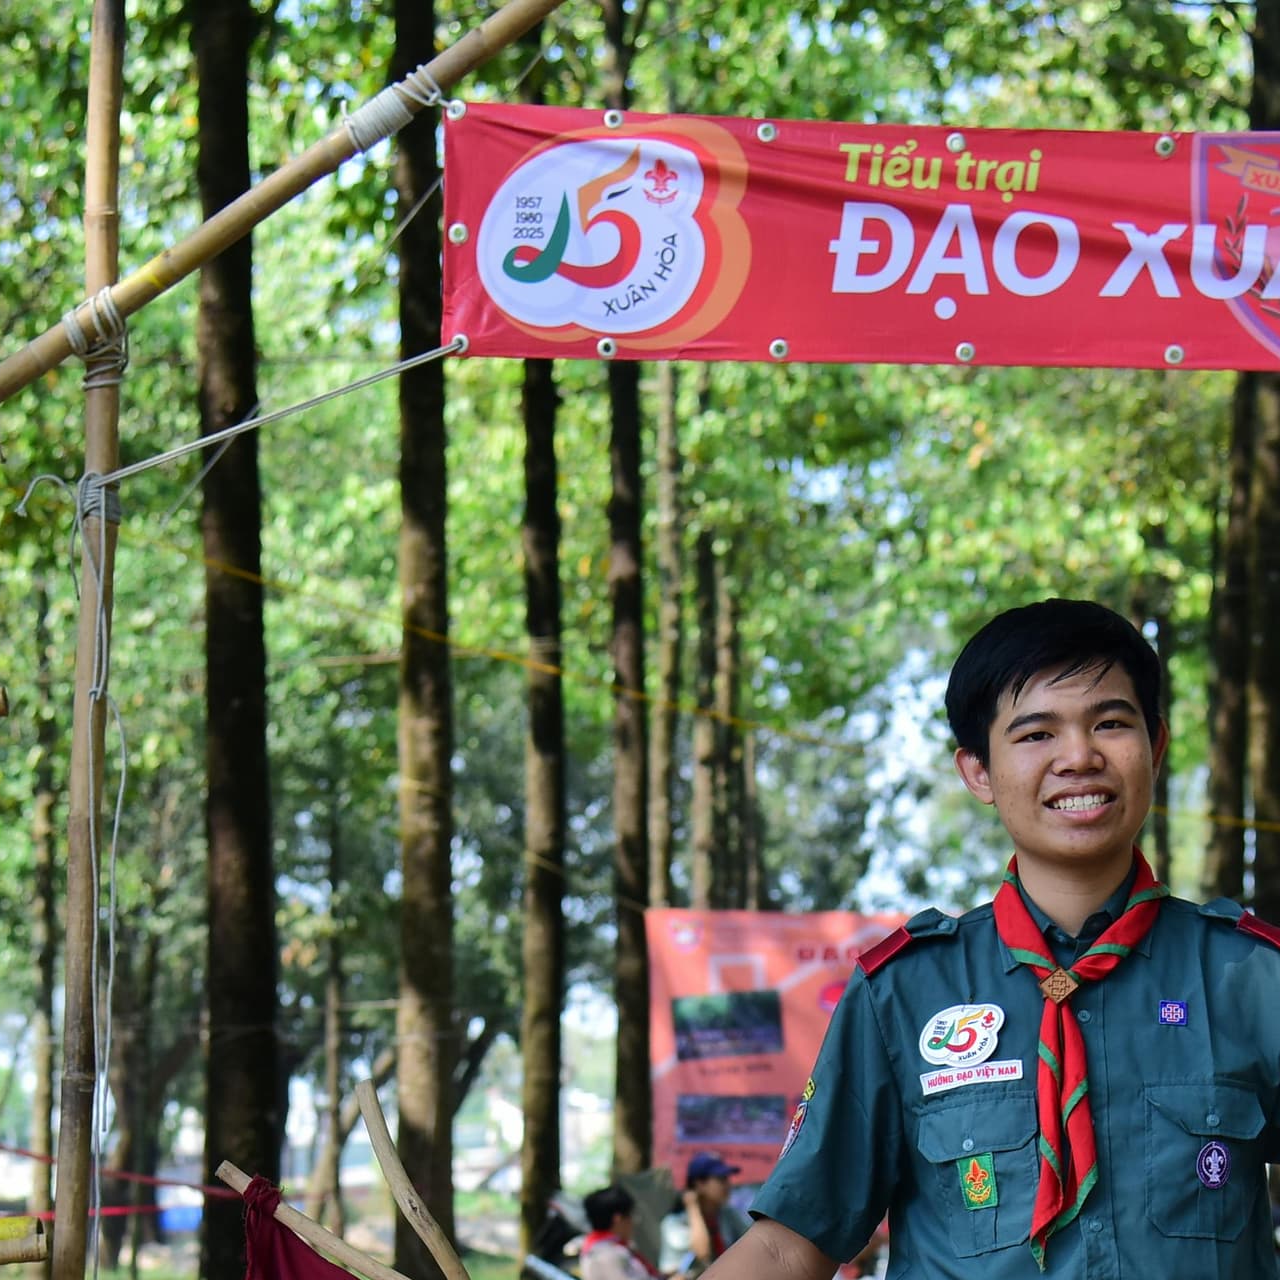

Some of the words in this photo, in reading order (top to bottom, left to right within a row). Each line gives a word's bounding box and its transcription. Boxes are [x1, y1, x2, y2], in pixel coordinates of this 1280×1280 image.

[839, 140, 943, 190] Tiểu
[955, 149, 1042, 203] trại
[515, 196, 543, 208] 1957
[513, 227, 545, 239] 2025
[828, 201, 1080, 319] ĐẠO
[602, 279, 657, 317] XUÂN
[654, 233, 678, 281] HÒA
[958, 1051, 977, 1061] XUÂN
[957, 1071, 973, 1082] ĐẠO
[976, 1066, 995, 1078] VIỆT
[998, 1066, 1017, 1076] NAM
